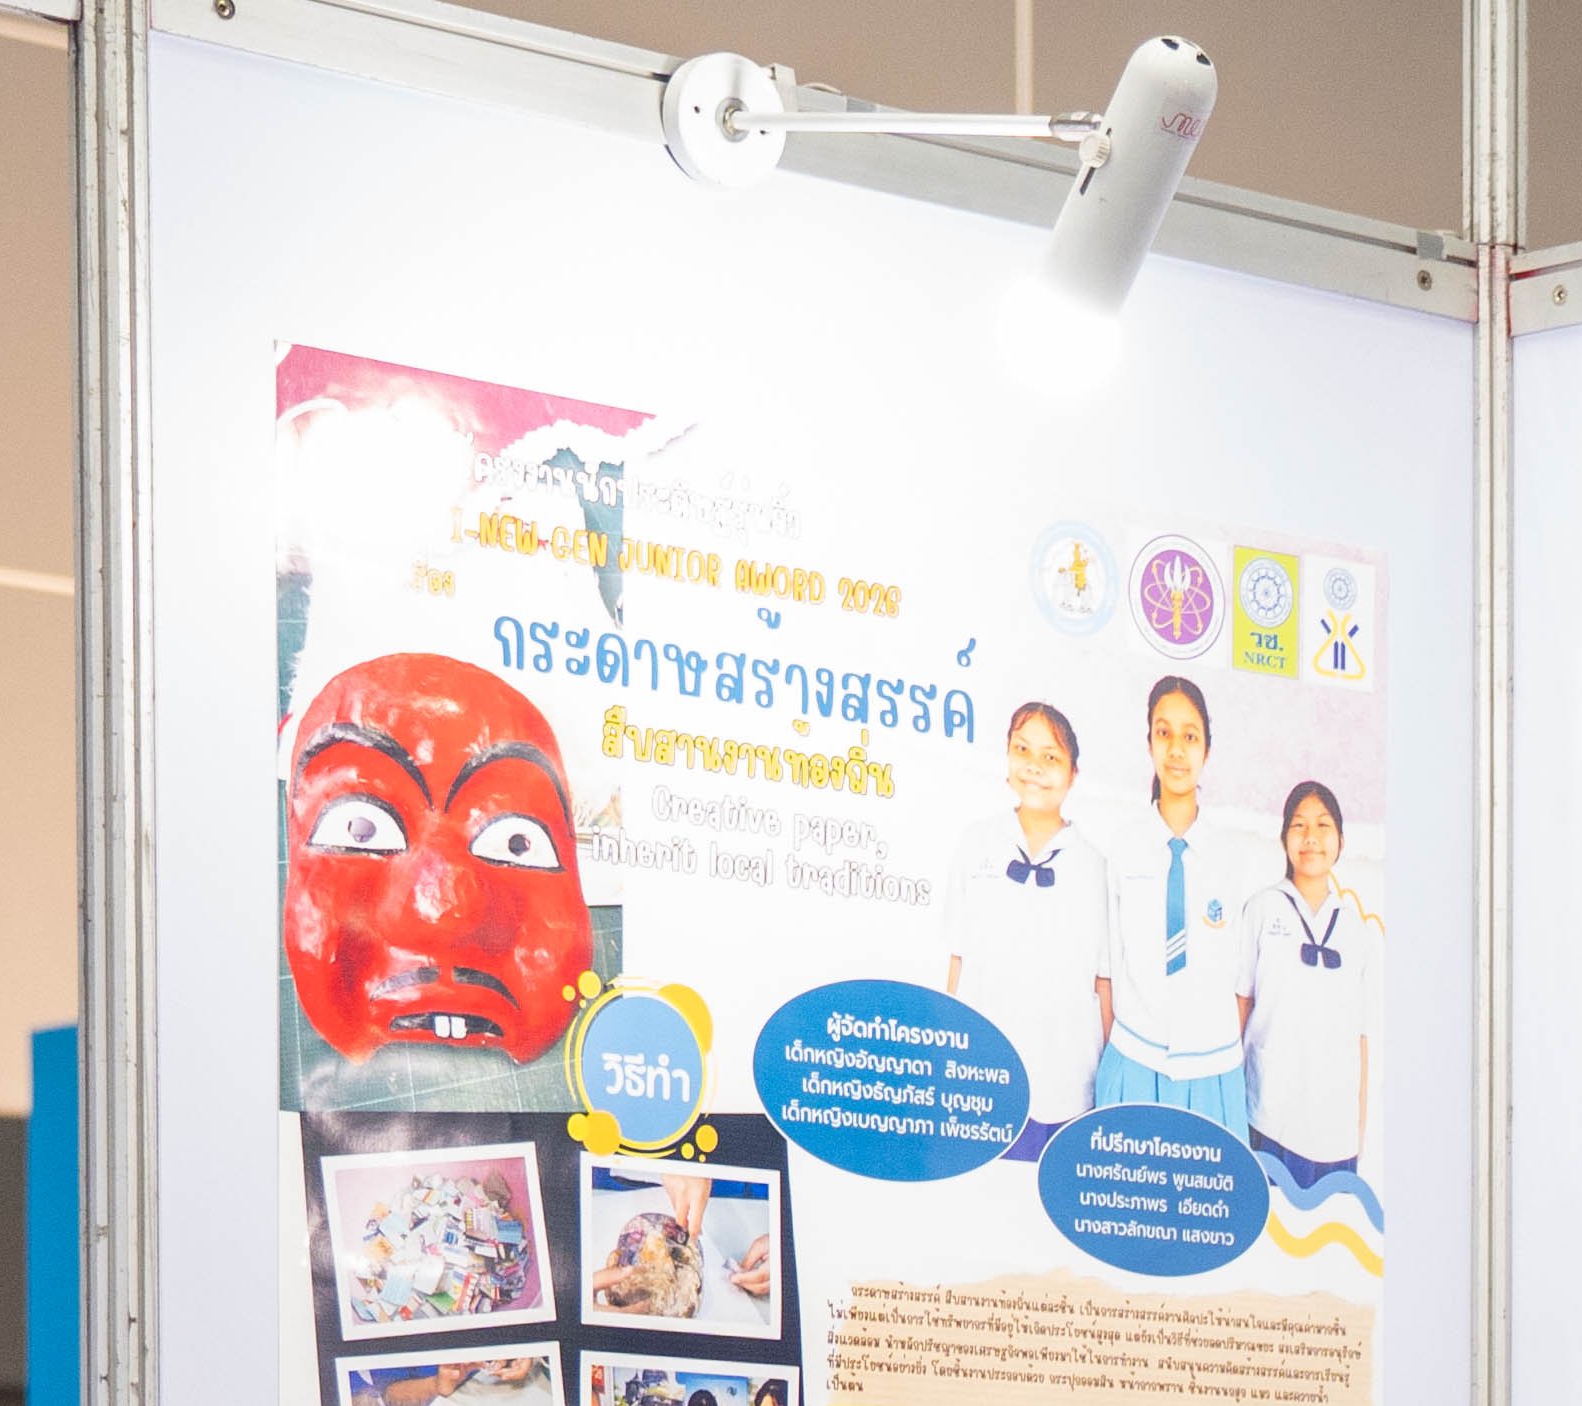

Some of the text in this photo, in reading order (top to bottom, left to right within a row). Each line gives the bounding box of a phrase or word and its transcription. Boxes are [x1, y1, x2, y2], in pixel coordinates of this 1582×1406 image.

[551, 526, 608, 569] GEN
[618, 538, 723, 588] JUNIOR
[735, 560, 825, 605] AWORD
[838, 578, 902, 618] 2026
[494, 606, 978, 743] กระดาษสร้างสรรค์
[1243, 650, 1287, 669] NRCT
[602, 705, 895, 798] สืบสานงานท้องถิ่น
[651, 785, 889, 860] Creative paper,
[591, 825, 932, 906] inherit local traditions
[826, 1012, 969, 1050] ผู้จัดทำโครงงาน
[601, 1052, 691, 1104] วิธีทำ
[785, 1039, 1010, 1085] เด็กหญิงอัญญาดา สิงหะพล
[941, 1092, 994, 1116] บุญชุม
[1090, 1126, 1221, 1162] ที่ปรึกษาโครงงาน
[1079, 1190, 1168, 1212] นางประภาพร
[1172, 1171, 1234, 1193] พูนสมบัติ
[1182, 1229, 1235, 1246] แสงขาว
